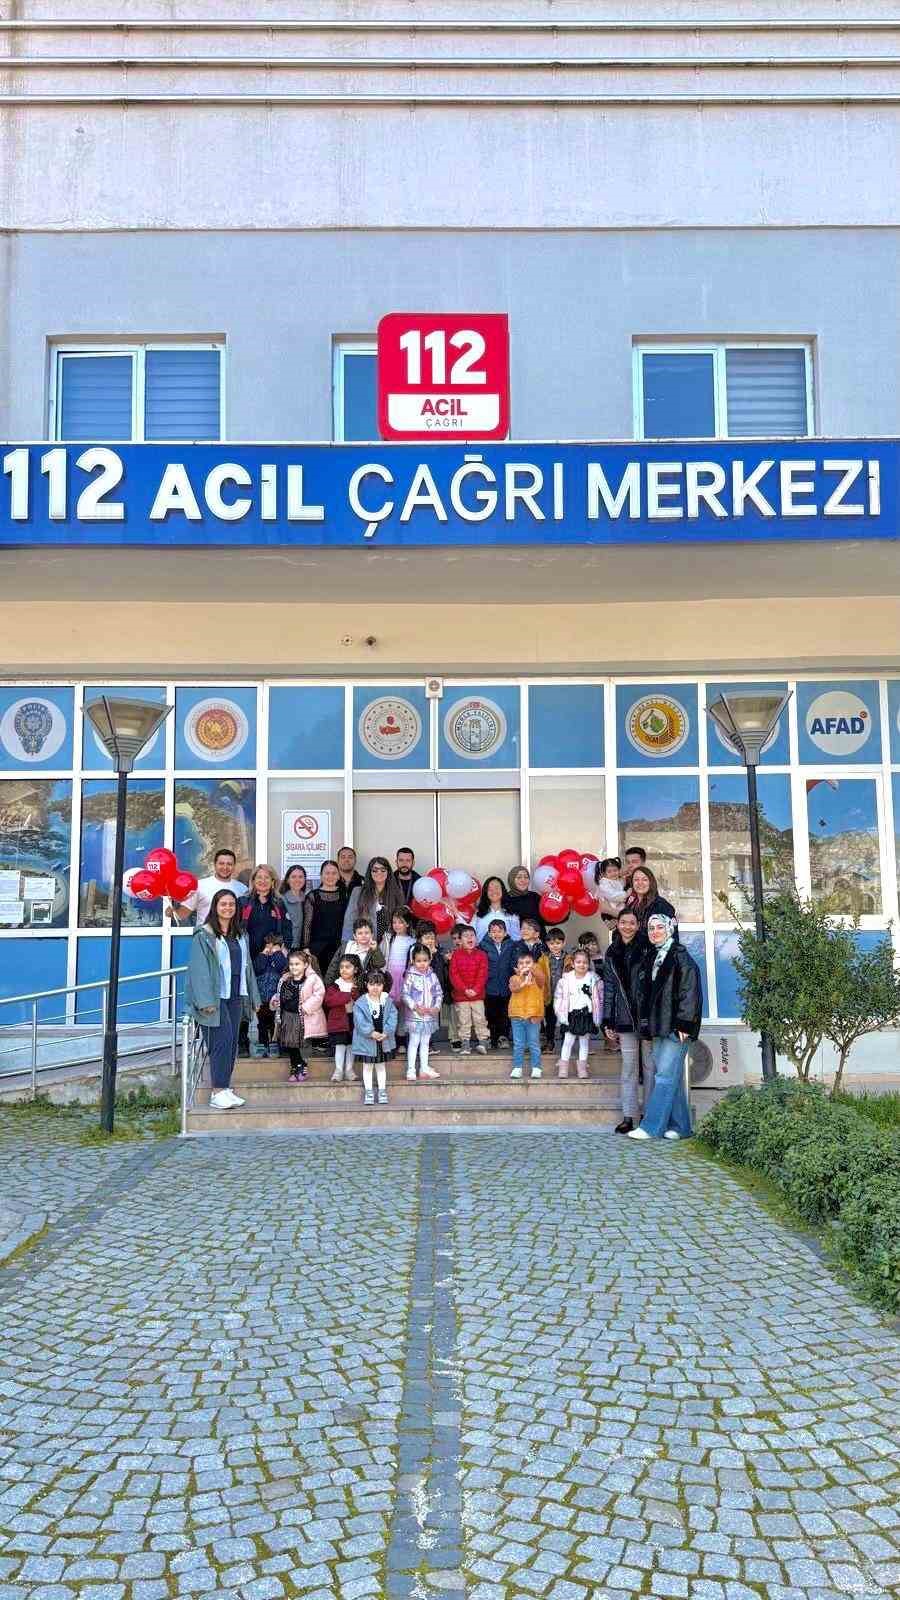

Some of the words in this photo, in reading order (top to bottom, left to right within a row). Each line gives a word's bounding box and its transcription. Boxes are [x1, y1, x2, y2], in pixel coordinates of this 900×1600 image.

[399, 329, 487, 385] 112
[425, 417, 463, 429] ÇAĞRI
[2, 447, 125, 521] 112
[348, 454, 564, 537] ÇAĞRI
[587, 460, 881, 520] MERKEZİ
[809, 716, 865, 735] AFAD
